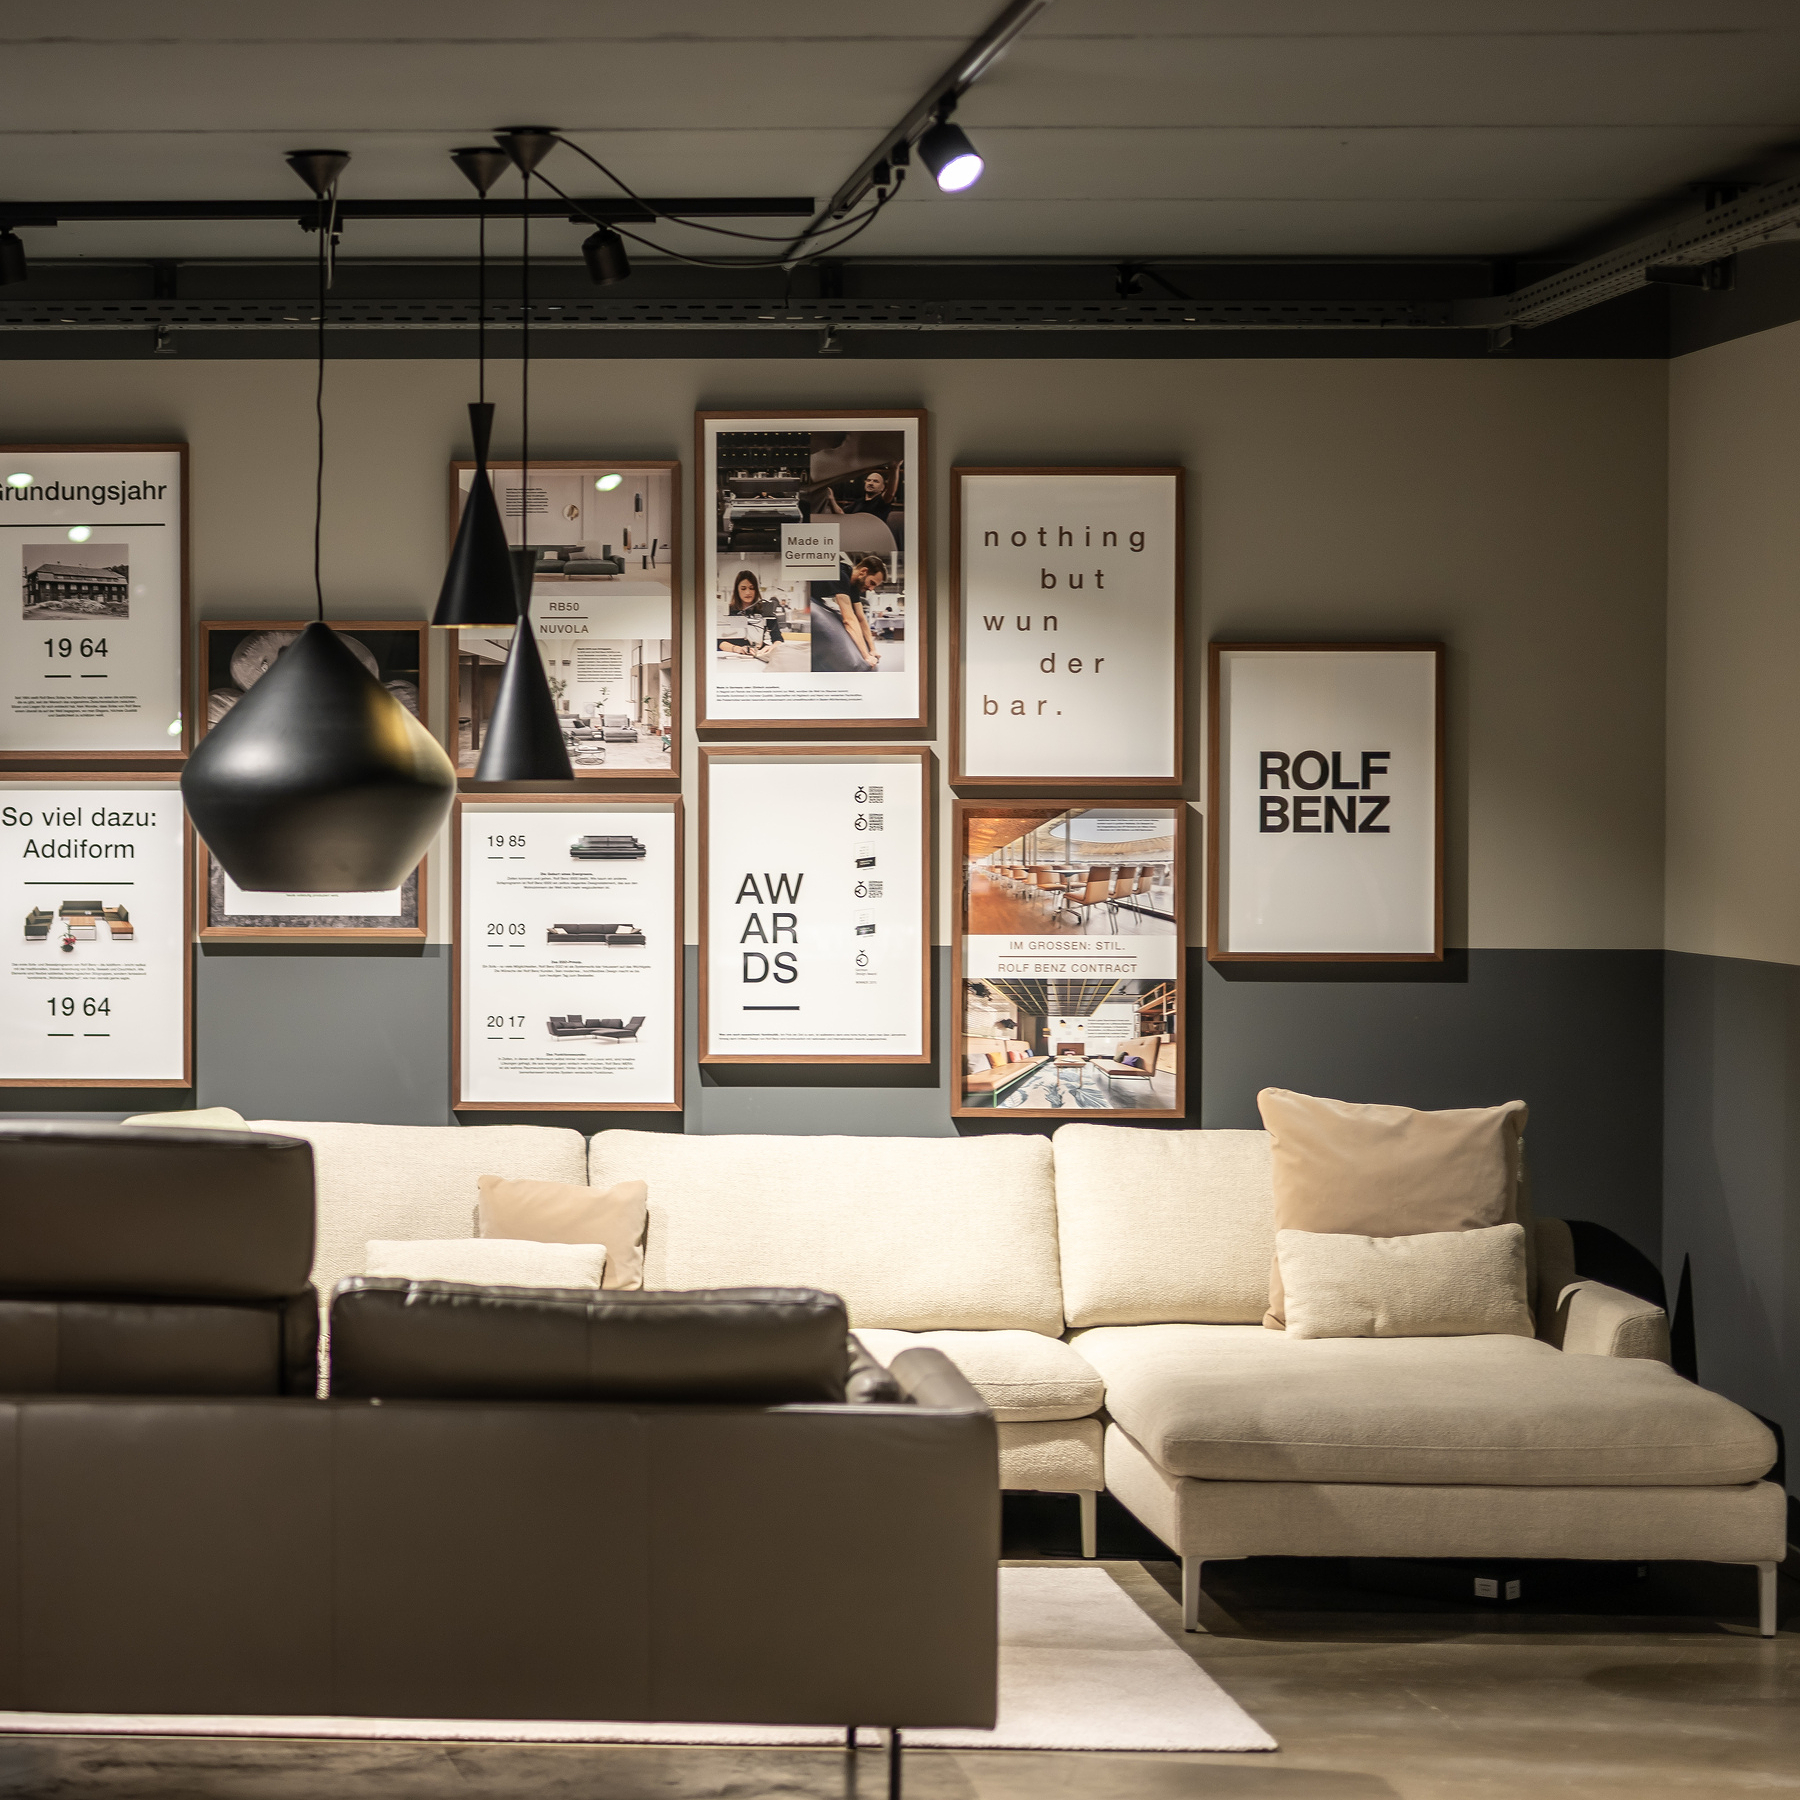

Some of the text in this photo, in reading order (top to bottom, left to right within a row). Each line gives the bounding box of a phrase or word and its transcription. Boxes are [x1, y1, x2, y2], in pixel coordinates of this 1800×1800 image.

[787, 536, 834, 546] Made in
[984, 525, 1146, 553] nothing
[784, 550, 837, 562] Germany
[1041, 567, 1105, 590] but
[549, 602, 580, 612] RB50
[539, 624, 589, 634] NUVOLA
[983, 614, 1059, 632] wun
[43, 636, 109, 658] 19 64
[1040, 652, 1105, 674] der
[983, 694, 1063, 716] bar.
[1259, 750, 1392, 791] ROLF
[1, 806, 157, 827] So viel dazu:
[1259, 795, 1392, 834] BENZ
[22, 838, 136, 859] Addiform
[487, 834, 526, 848] 19 85
[734, 872, 804, 905] AW
[487, 923, 526, 936] 20 03
[739, 912, 799, 944] AR
[1009, 941, 1126, 951] IM GROSSEN: STIL.
[742, 951, 799, 984] DS
[998, 963, 1138, 973] ROLF BENZ CONTRACT
[47, 996, 111, 1017] 19 64
[487, 1015, 526, 1028] 20 17
